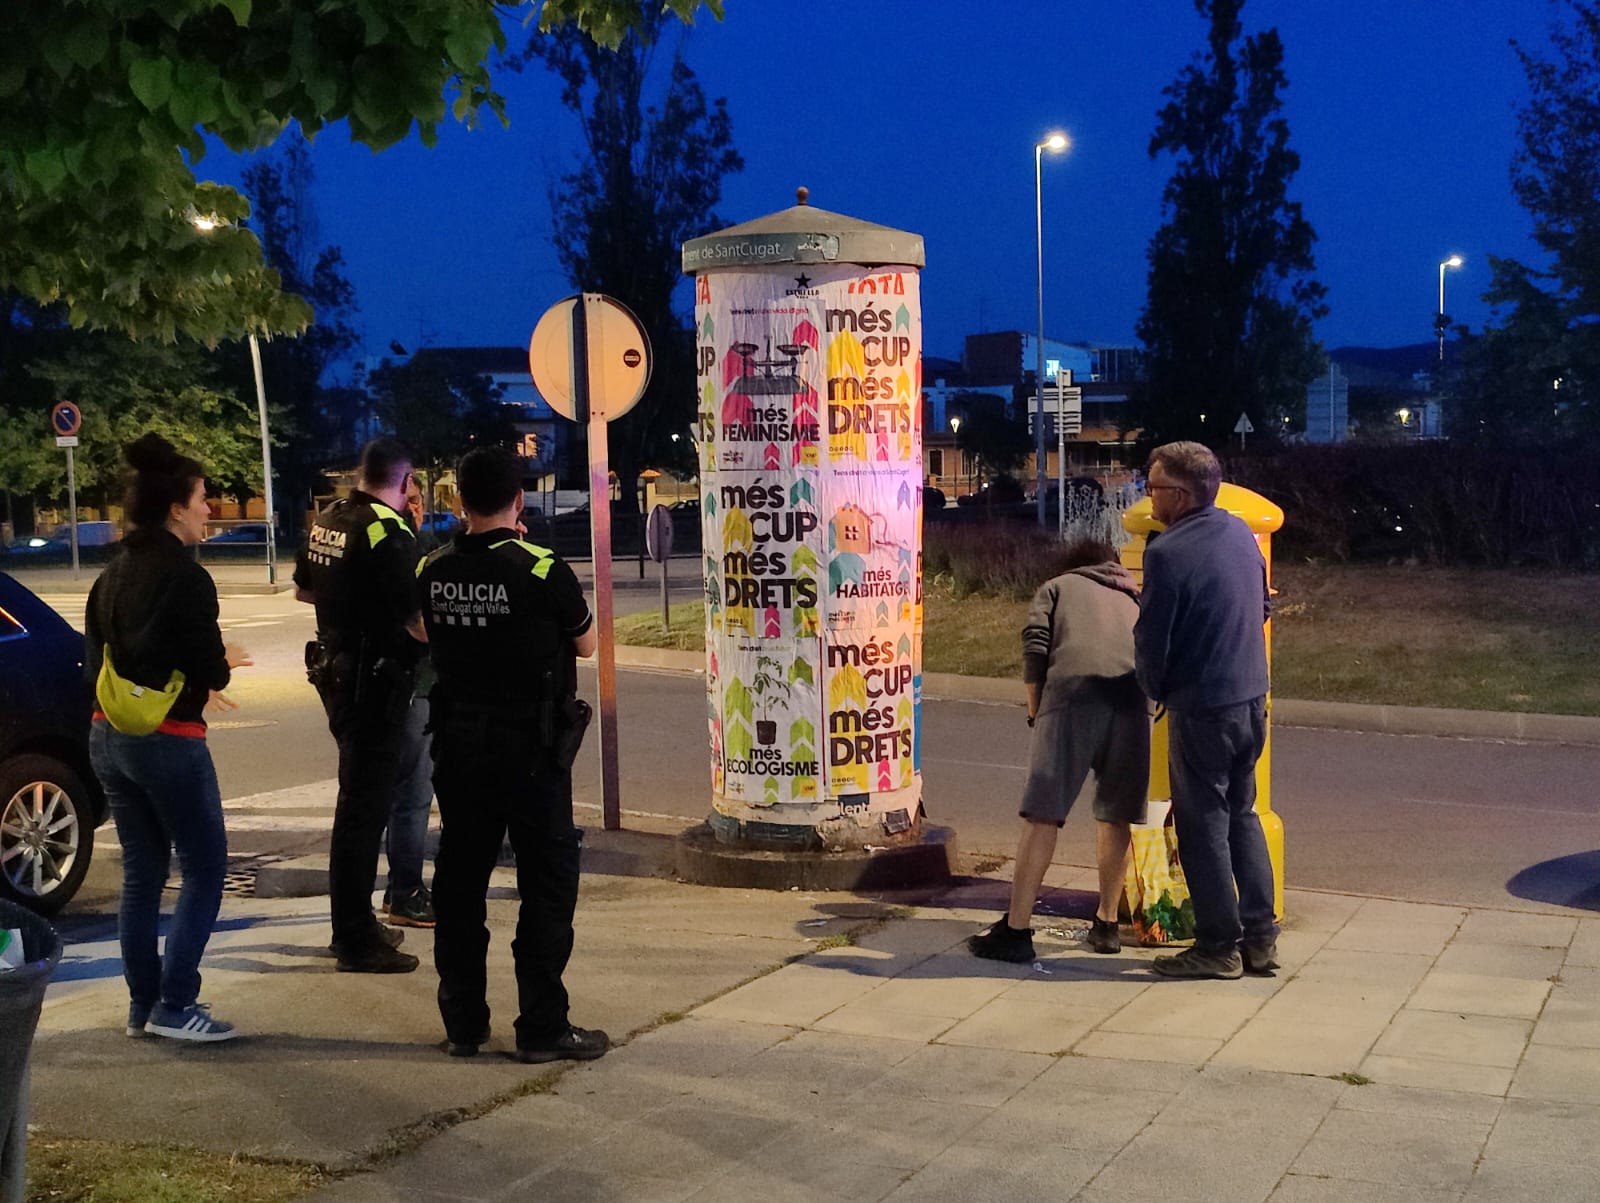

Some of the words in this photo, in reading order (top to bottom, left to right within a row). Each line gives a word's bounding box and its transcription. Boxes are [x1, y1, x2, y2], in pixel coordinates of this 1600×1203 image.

[702, 245, 714, 259] de
[826, 302, 892, 332] més
[861, 336, 911, 367] CUP
[827, 366, 893, 400] més
[746, 403, 788, 422] més
[828, 403, 911, 434] DRETS
[722, 424, 821, 441] FEMINISME
[721, 477, 785, 509] més
[749, 511, 818, 542] CUP
[724, 544, 787, 576] més
[863, 566, 892, 582] més
[430, 581, 509, 602] POLICIA
[725, 578, 818, 609] DRETS
[836, 581, 908, 598] HABITATGE
[449, 600, 472, 616] Cugat
[473, 602, 485, 614] del
[828, 635, 894, 668] més
[864, 664, 912, 698] CUP
[829, 701, 894, 734] més
[750, 745, 783, 760] més
[830, 729, 912, 766] DRETS
[727, 758, 819, 776] ECOLOGISME
